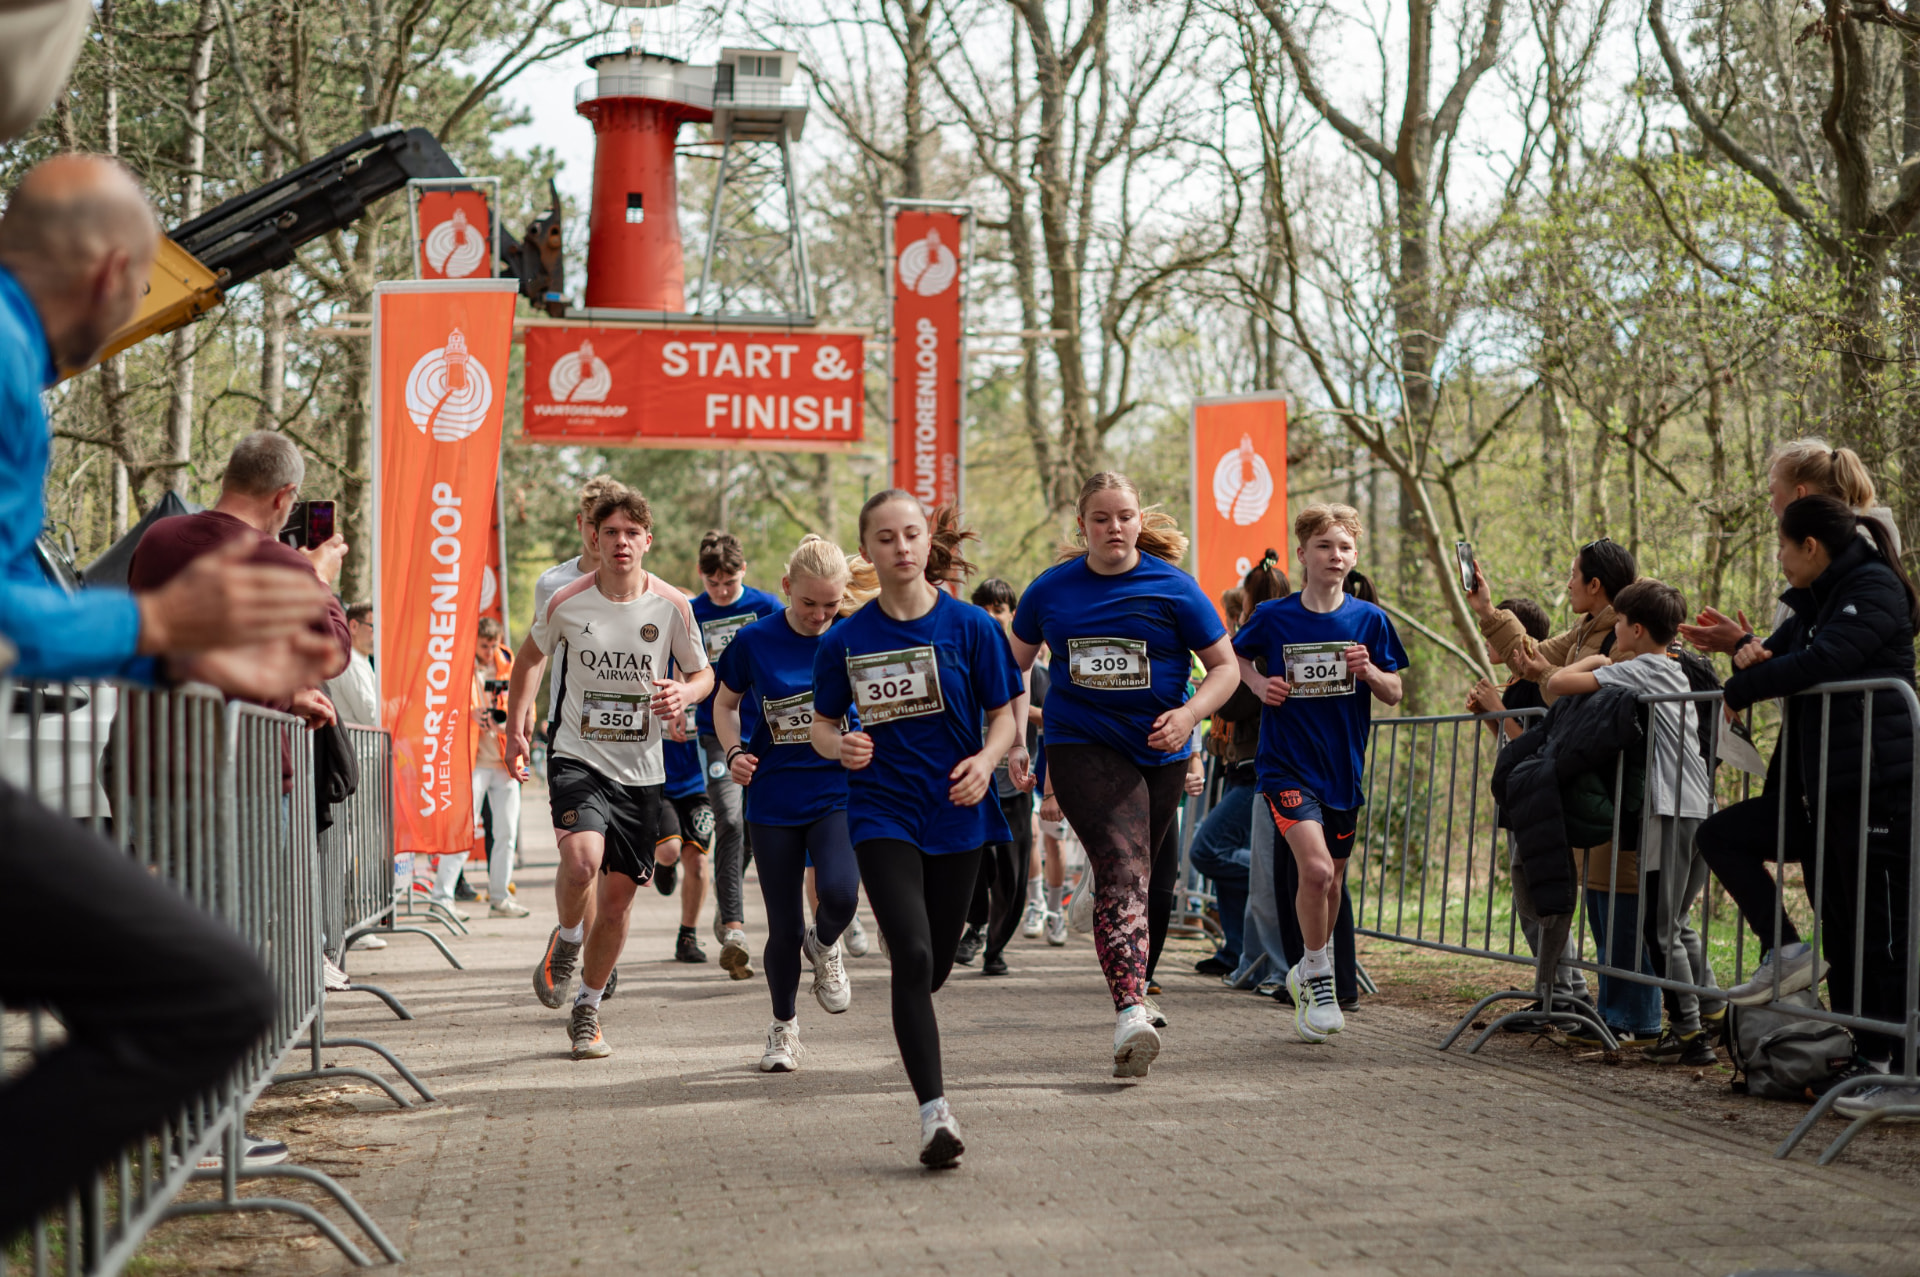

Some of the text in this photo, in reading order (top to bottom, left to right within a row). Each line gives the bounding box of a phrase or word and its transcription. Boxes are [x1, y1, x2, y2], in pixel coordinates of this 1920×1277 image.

[662, 341, 854, 381] START &
[706, 393, 853, 431] FINISH
[419, 481, 462, 817] VUURTORENLOOP
[580, 649, 653, 671] QATAR
[1090, 657, 1128, 672] 309
[596, 669, 651, 682] AIRWAYS
[1303, 664, 1338, 680] 304
[867, 679, 914, 701] 302
[1110, 677, 1146, 687] Vlieland
[1290, 683, 1352, 694] Jan van Vlieland
[859, 700, 939, 721] an van Vlieland
[599, 712, 633, 727] 350
[787, 713, 813, 727] 30
[582, 731, 597, 739] Jan
[615, 733, 647, 741] Vlieland
[441, 708, 460, 811] VLIELAND
